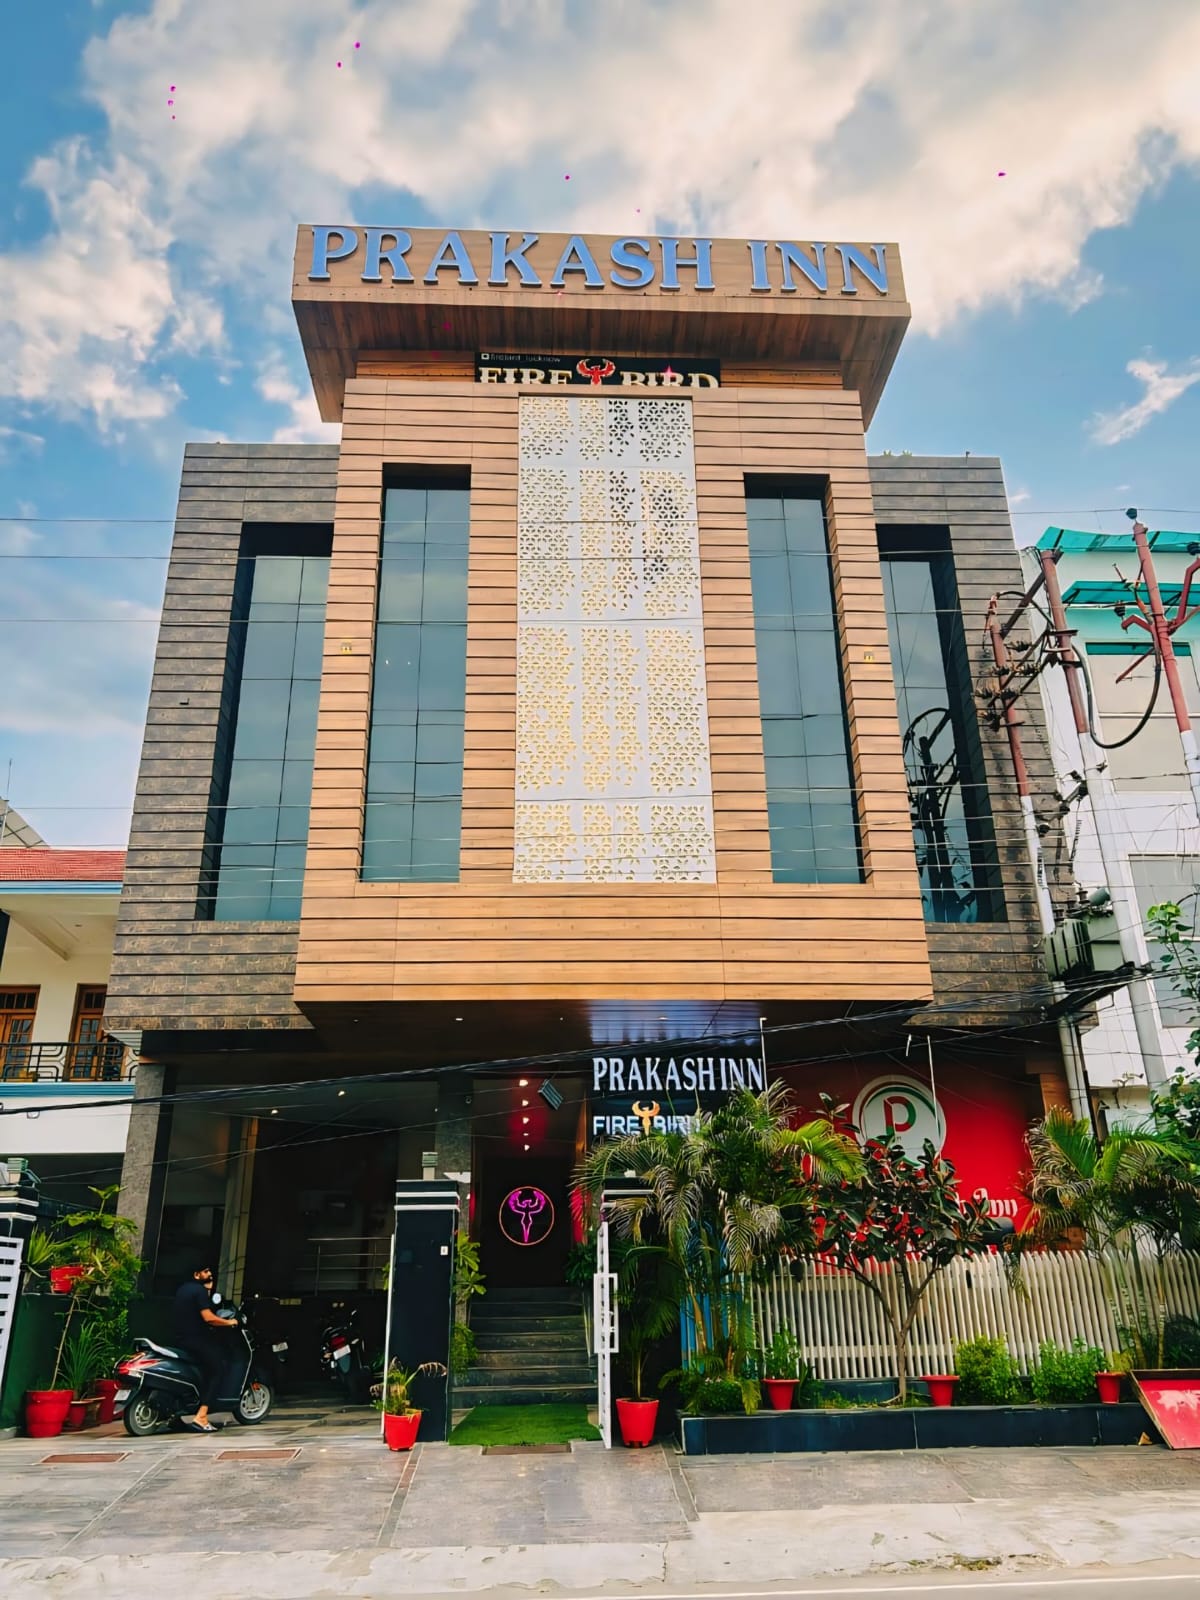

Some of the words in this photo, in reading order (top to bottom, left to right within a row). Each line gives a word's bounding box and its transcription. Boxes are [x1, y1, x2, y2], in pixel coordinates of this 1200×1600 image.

[308, 226, 715, 290] PRAKASH
[747, 240, 889, 295] INN
[478, 367, 572, 384] FIRE
[620, 371, 719, 388] BIRD
[593, 1115, 641, 1135] FIRE
[653, 1115, 701, 1136] BIR
